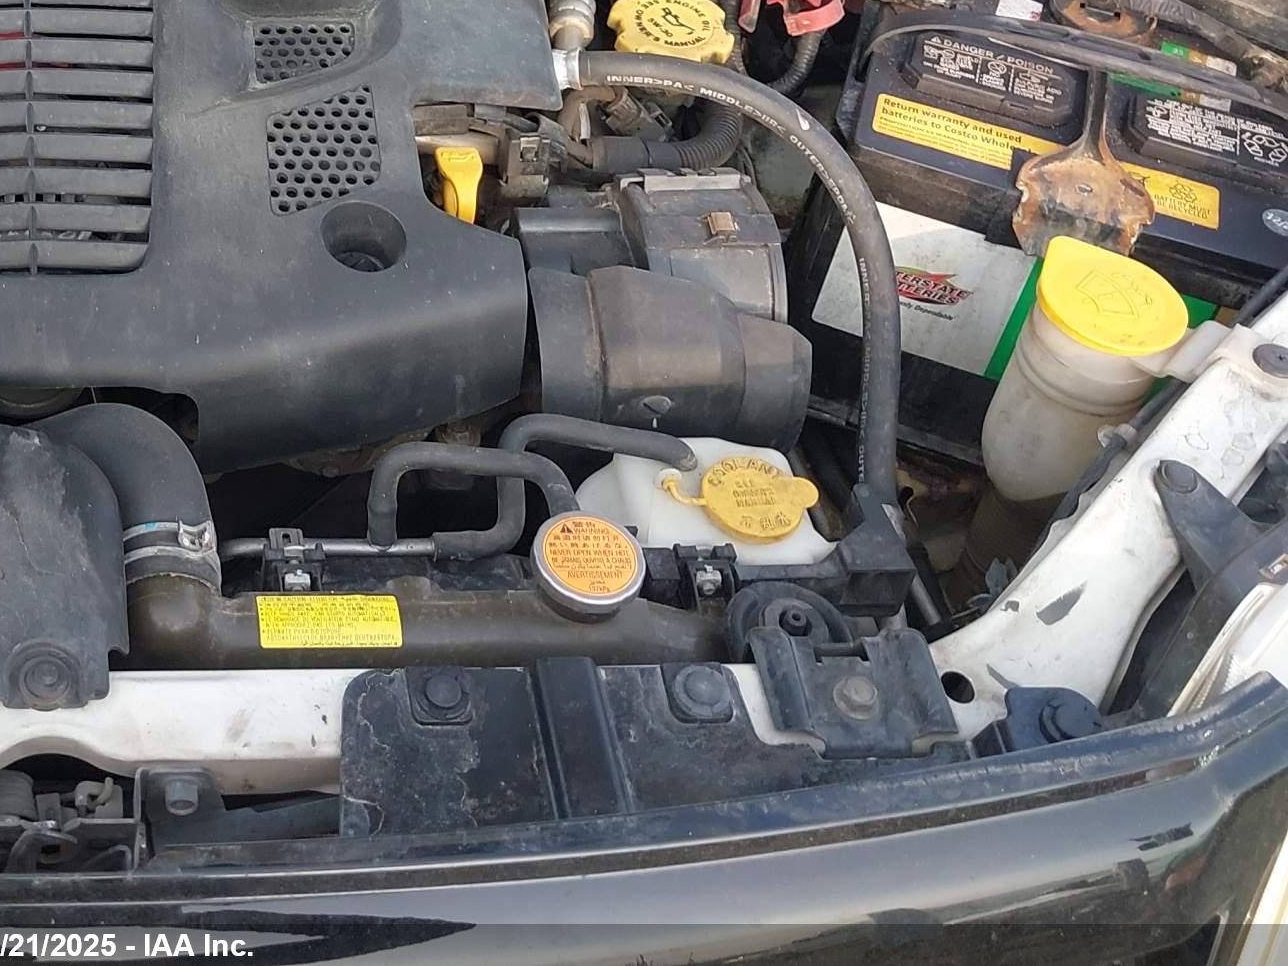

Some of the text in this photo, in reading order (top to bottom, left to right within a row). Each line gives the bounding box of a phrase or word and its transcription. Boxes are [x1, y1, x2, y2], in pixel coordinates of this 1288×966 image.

[701, 19, 711, 32] OIL
[664, 35, 707, 47] MANUAL
[943, 39, 994, 58] DANGER
[1007, 56, 1054, 75] POISON
[881, 107, 928, 126] batteries
[931, 119, 942, 129] to
[944, 126, 978, 141] Costco
[883, 98, 1022, 144] Return warranty and used
[1154, 193, 1211, 215] BATTERY MUST
[1168, 203, 1209, 219] RECYCLED
[896, 271, 969, 298] TERSTATE
